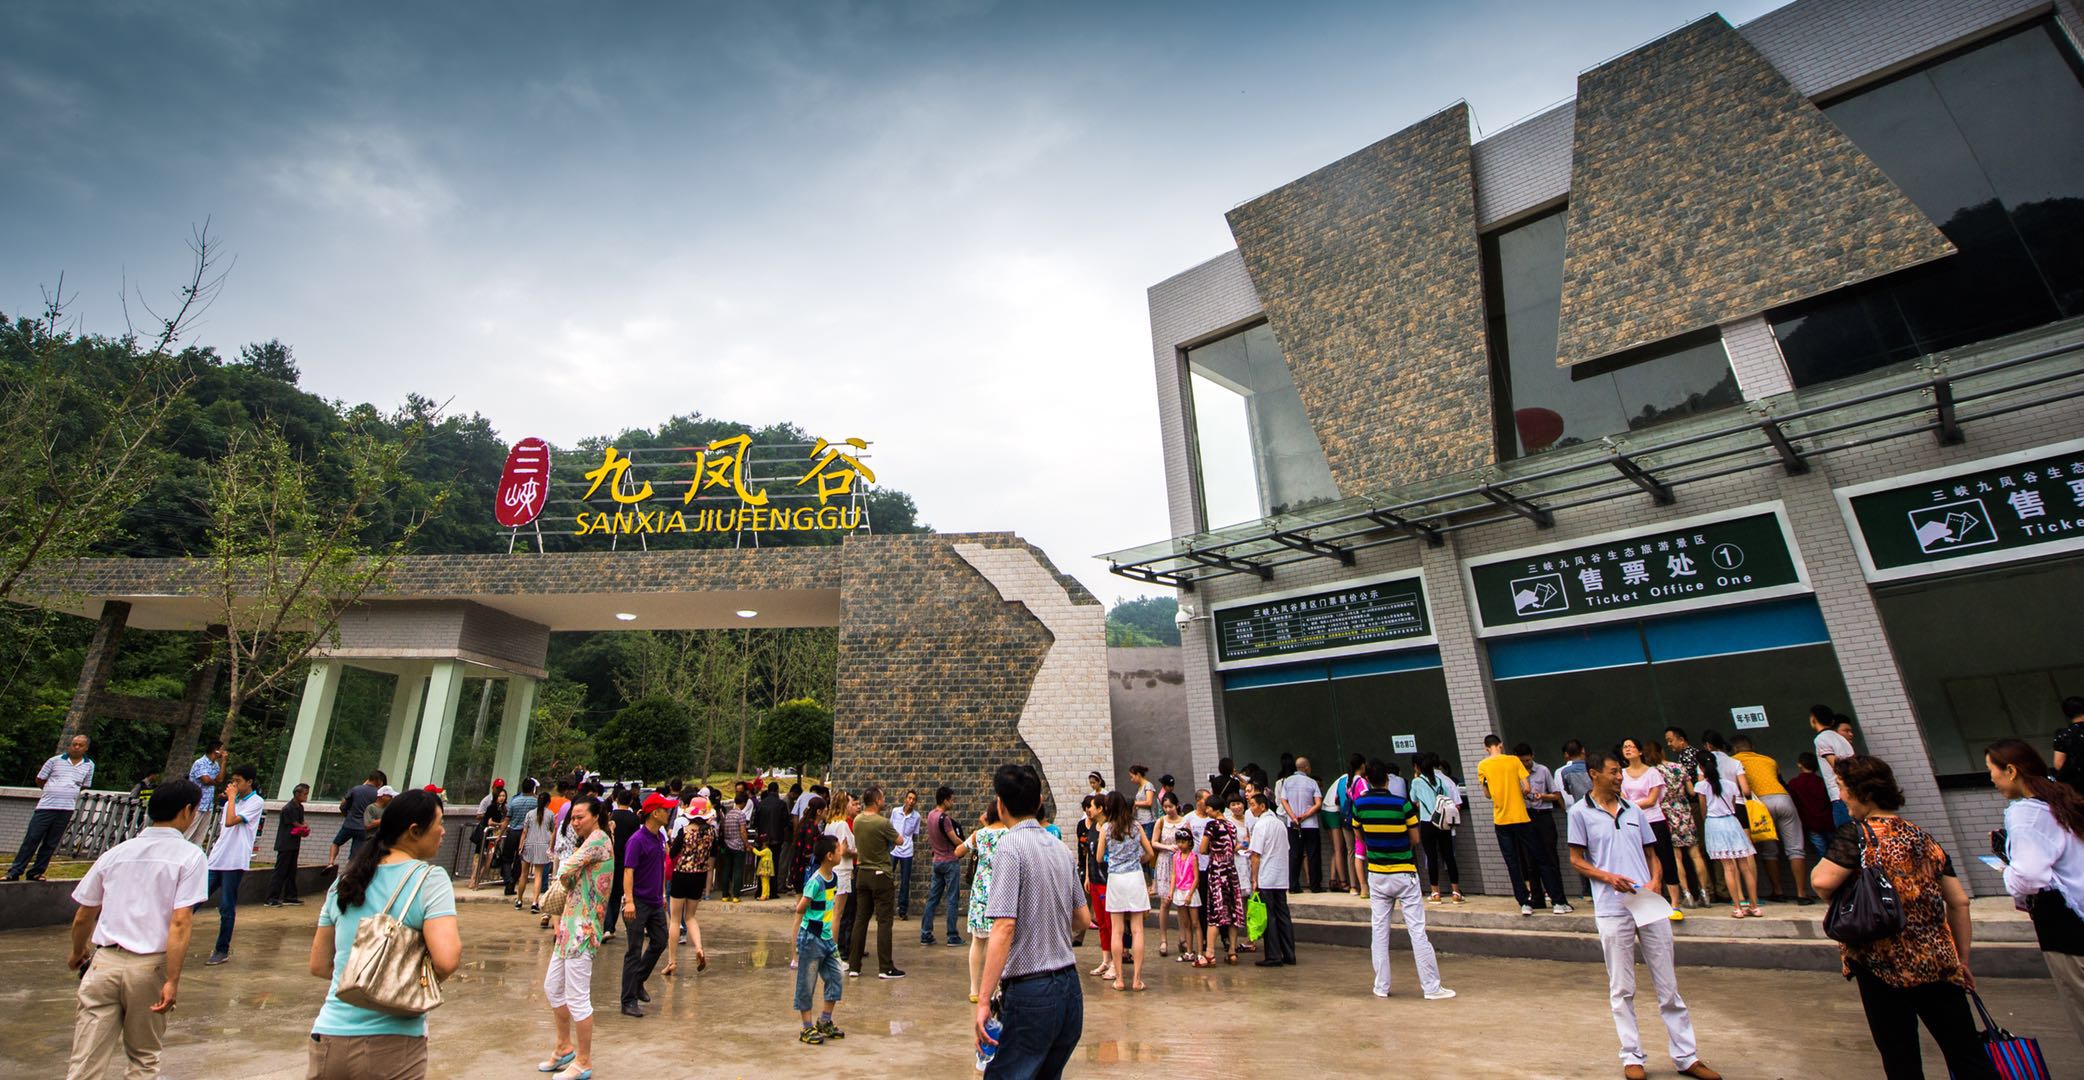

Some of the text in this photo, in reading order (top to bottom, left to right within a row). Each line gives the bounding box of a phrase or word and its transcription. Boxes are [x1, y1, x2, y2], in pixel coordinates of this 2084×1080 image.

[582, 433, 876, 506] 九凤谷
[574, 505, 862, 537] SANXIA JIUFENGGU
[1527, 534, 1706, 574] 三峡九凤谷生态旅游景区
[1577, 552, 1698, 593] 售票处
[1253, 590, 1379, 617] 三峡九凤谷景区门票票价公示
[1585, 573, 1753, 607] Ticket Office One
